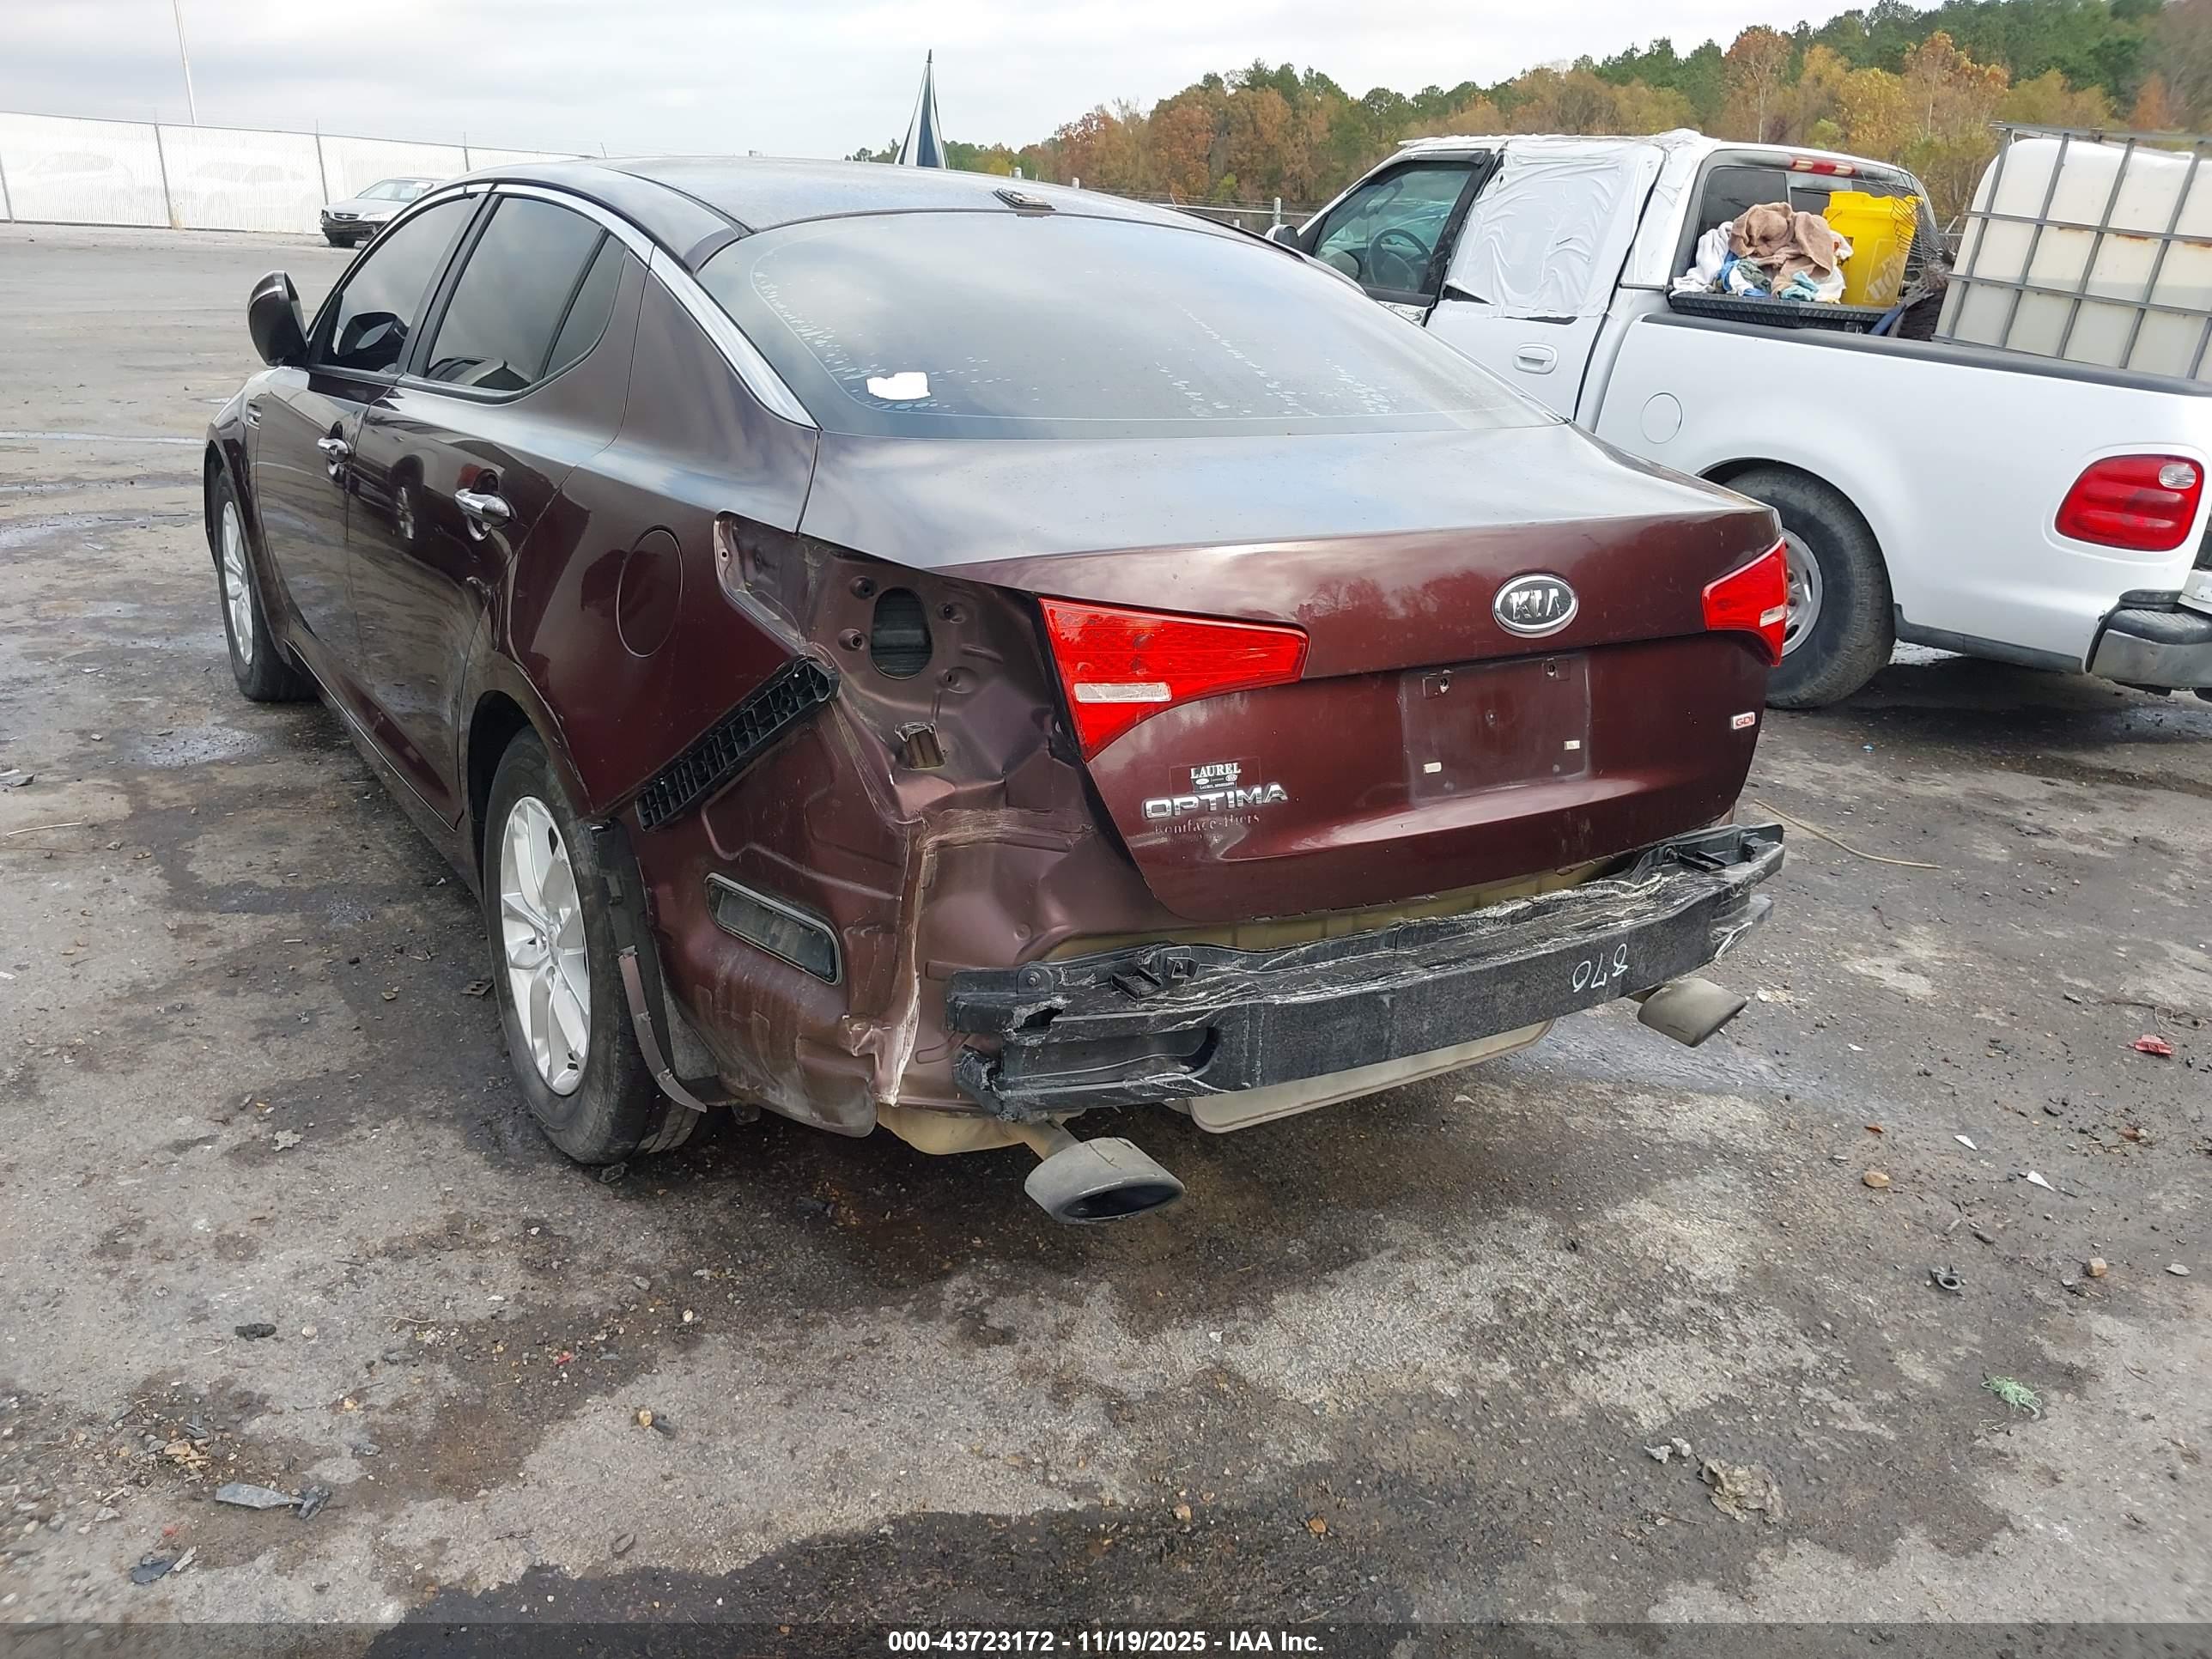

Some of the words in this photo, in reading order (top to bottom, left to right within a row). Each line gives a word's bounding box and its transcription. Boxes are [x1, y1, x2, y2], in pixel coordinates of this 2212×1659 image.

[1510, 588, 1565, 621] KIA
[1190, 763, 1242, 779] LAUREL
[1144, 782, 1288, 818] OPTIMA
